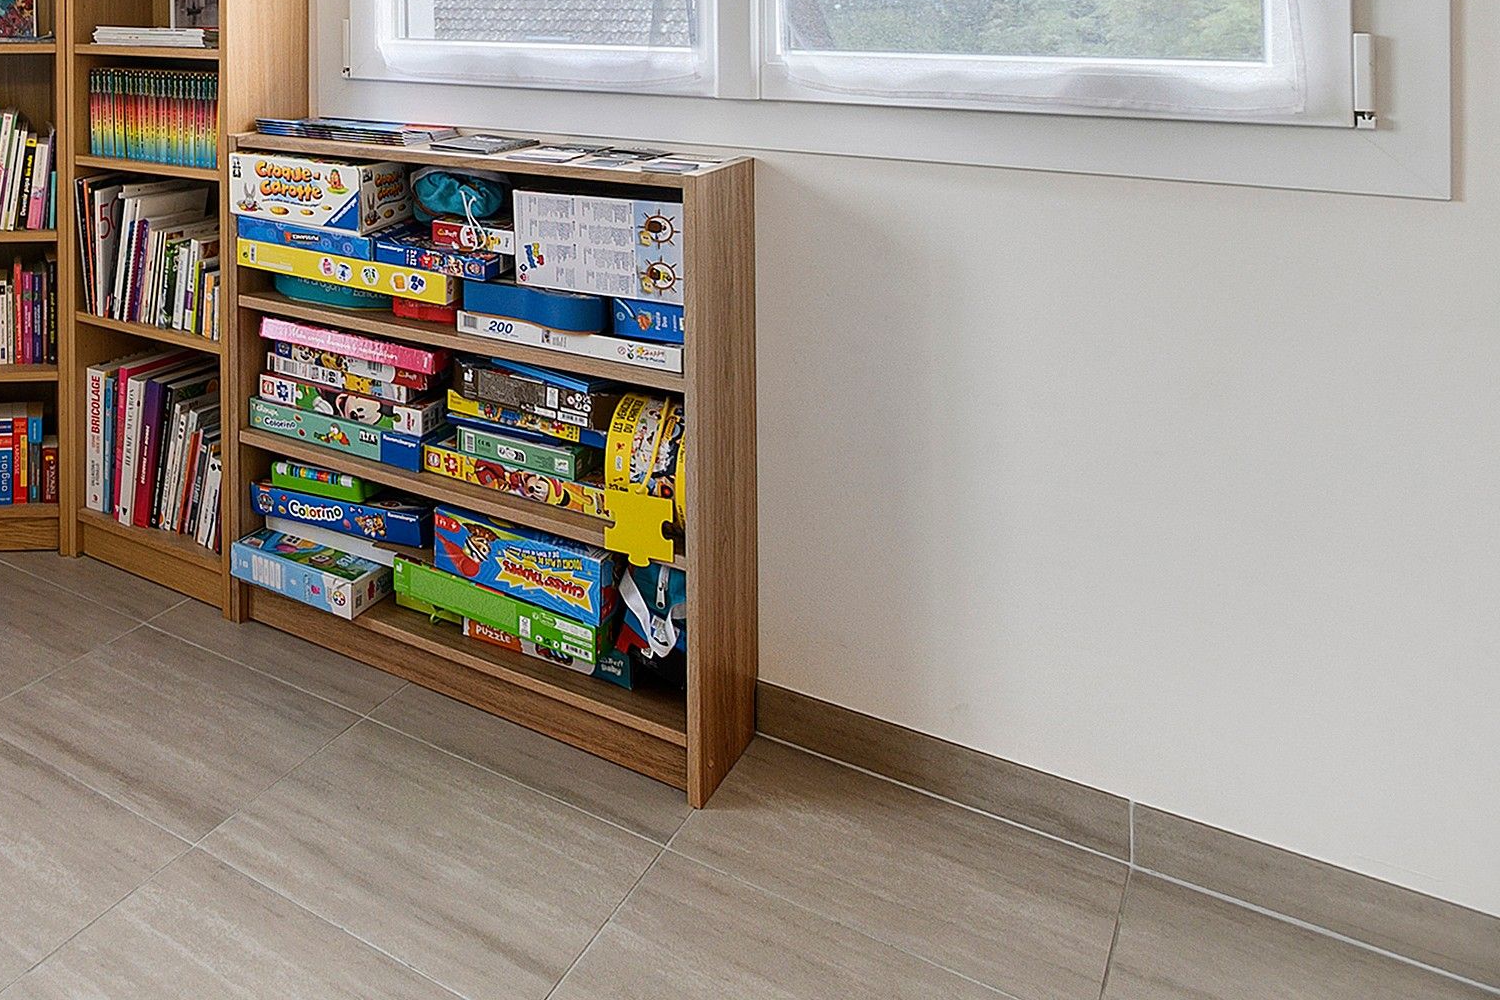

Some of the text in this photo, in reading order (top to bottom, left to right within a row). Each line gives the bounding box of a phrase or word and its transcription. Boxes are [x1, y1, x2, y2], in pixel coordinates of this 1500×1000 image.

[22, 178, 30, 193] papa
[260, 180, 323, 201] Carotte
[19, 194, 28, 216] Devenir
[488, 320, 514, 335] 200
[91, 376, 100, 434] BRICOLAGE
[126, 389, 135, 430] MACARON
[264, 416, 296, 429] Colorino
[288, 500, 344, 522] Colorino
[475, 626, 512, 645] PUZZLE
